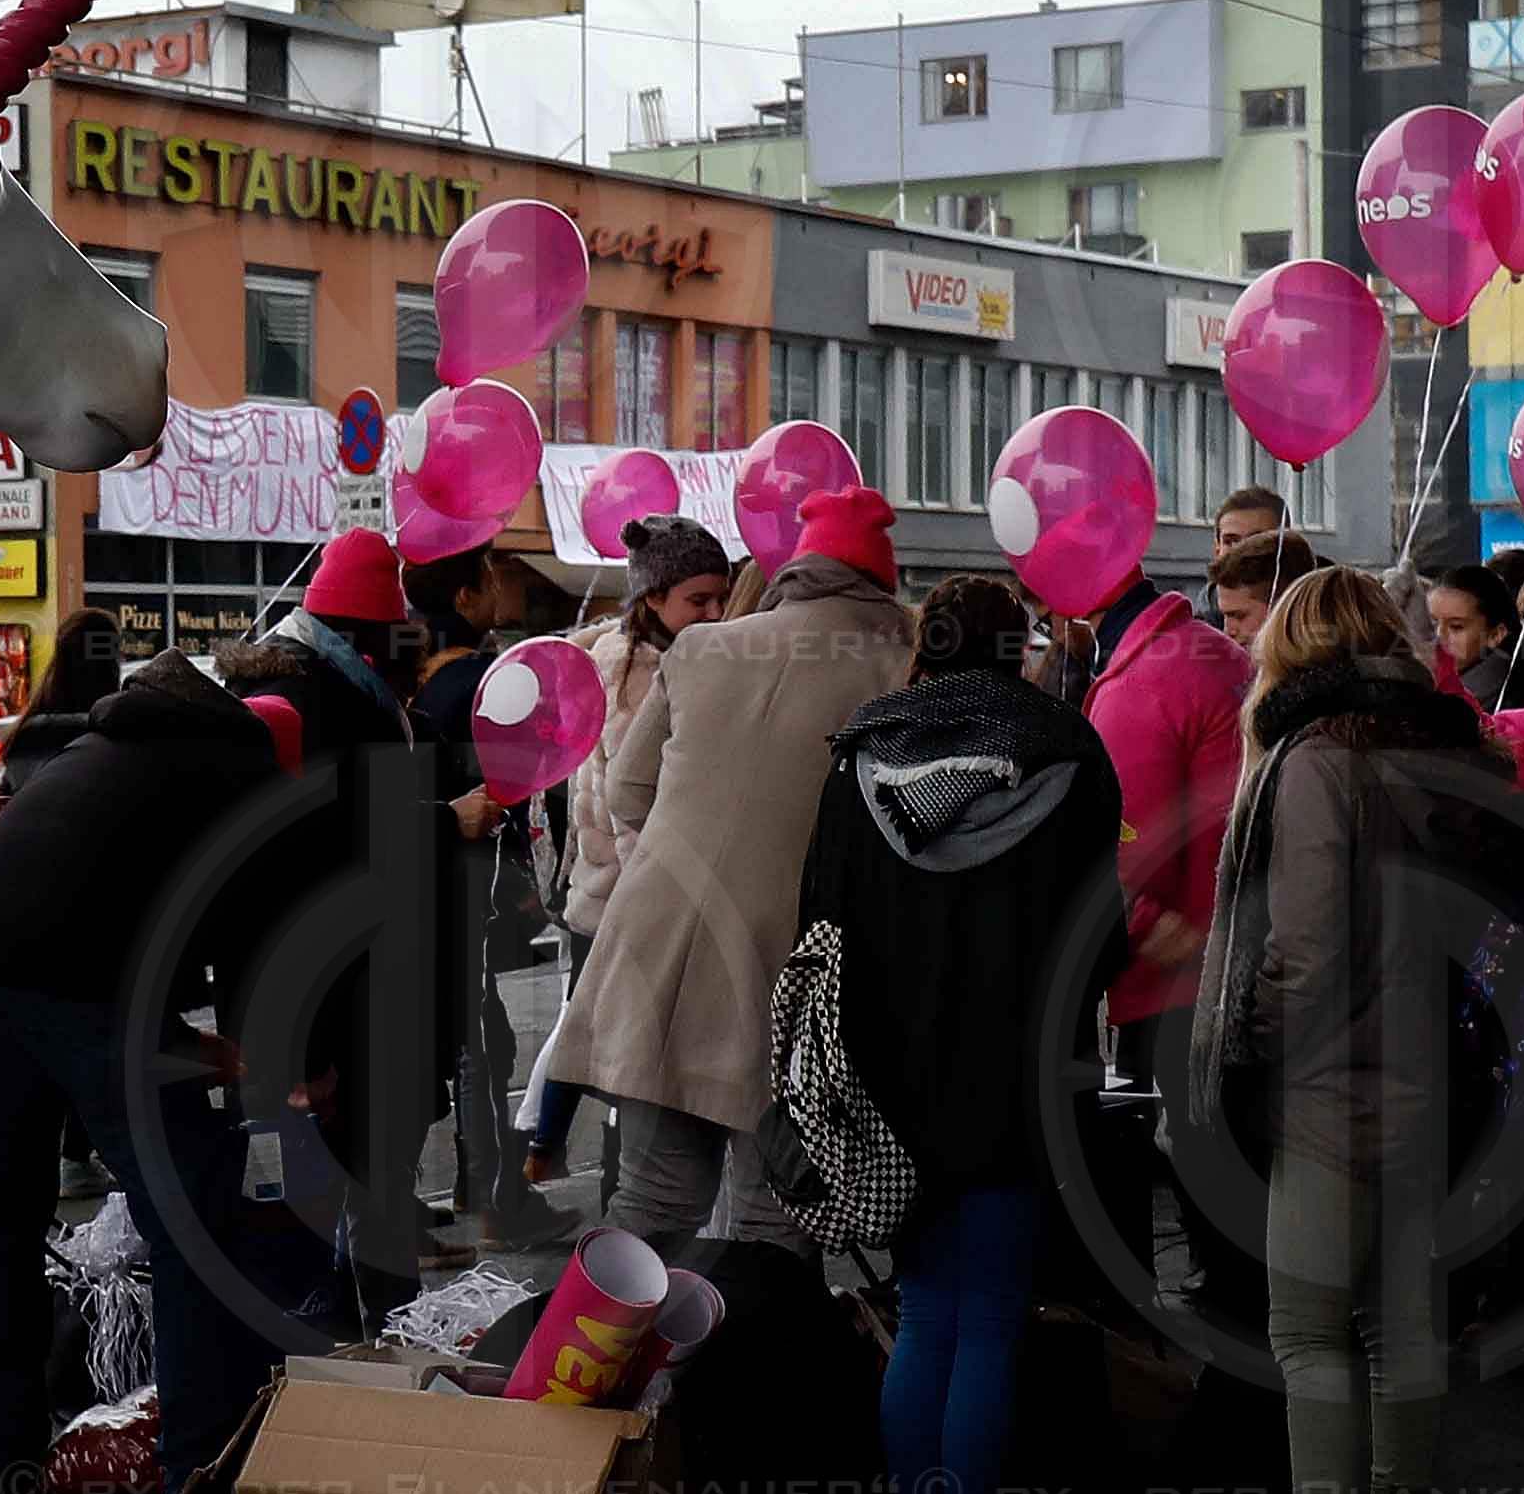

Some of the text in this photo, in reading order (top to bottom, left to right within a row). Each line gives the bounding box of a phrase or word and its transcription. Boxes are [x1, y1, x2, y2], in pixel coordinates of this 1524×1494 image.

[35, 19, 210, 78] eorgi
[67, 119, 483, 238] RESTAURANT
[1358, 190, 1433, 225] neos
[905, 268, 968, 313] VIDEO
[1197, 314, 1226, 352] VID
[228, 470, 339, 536] MUND
